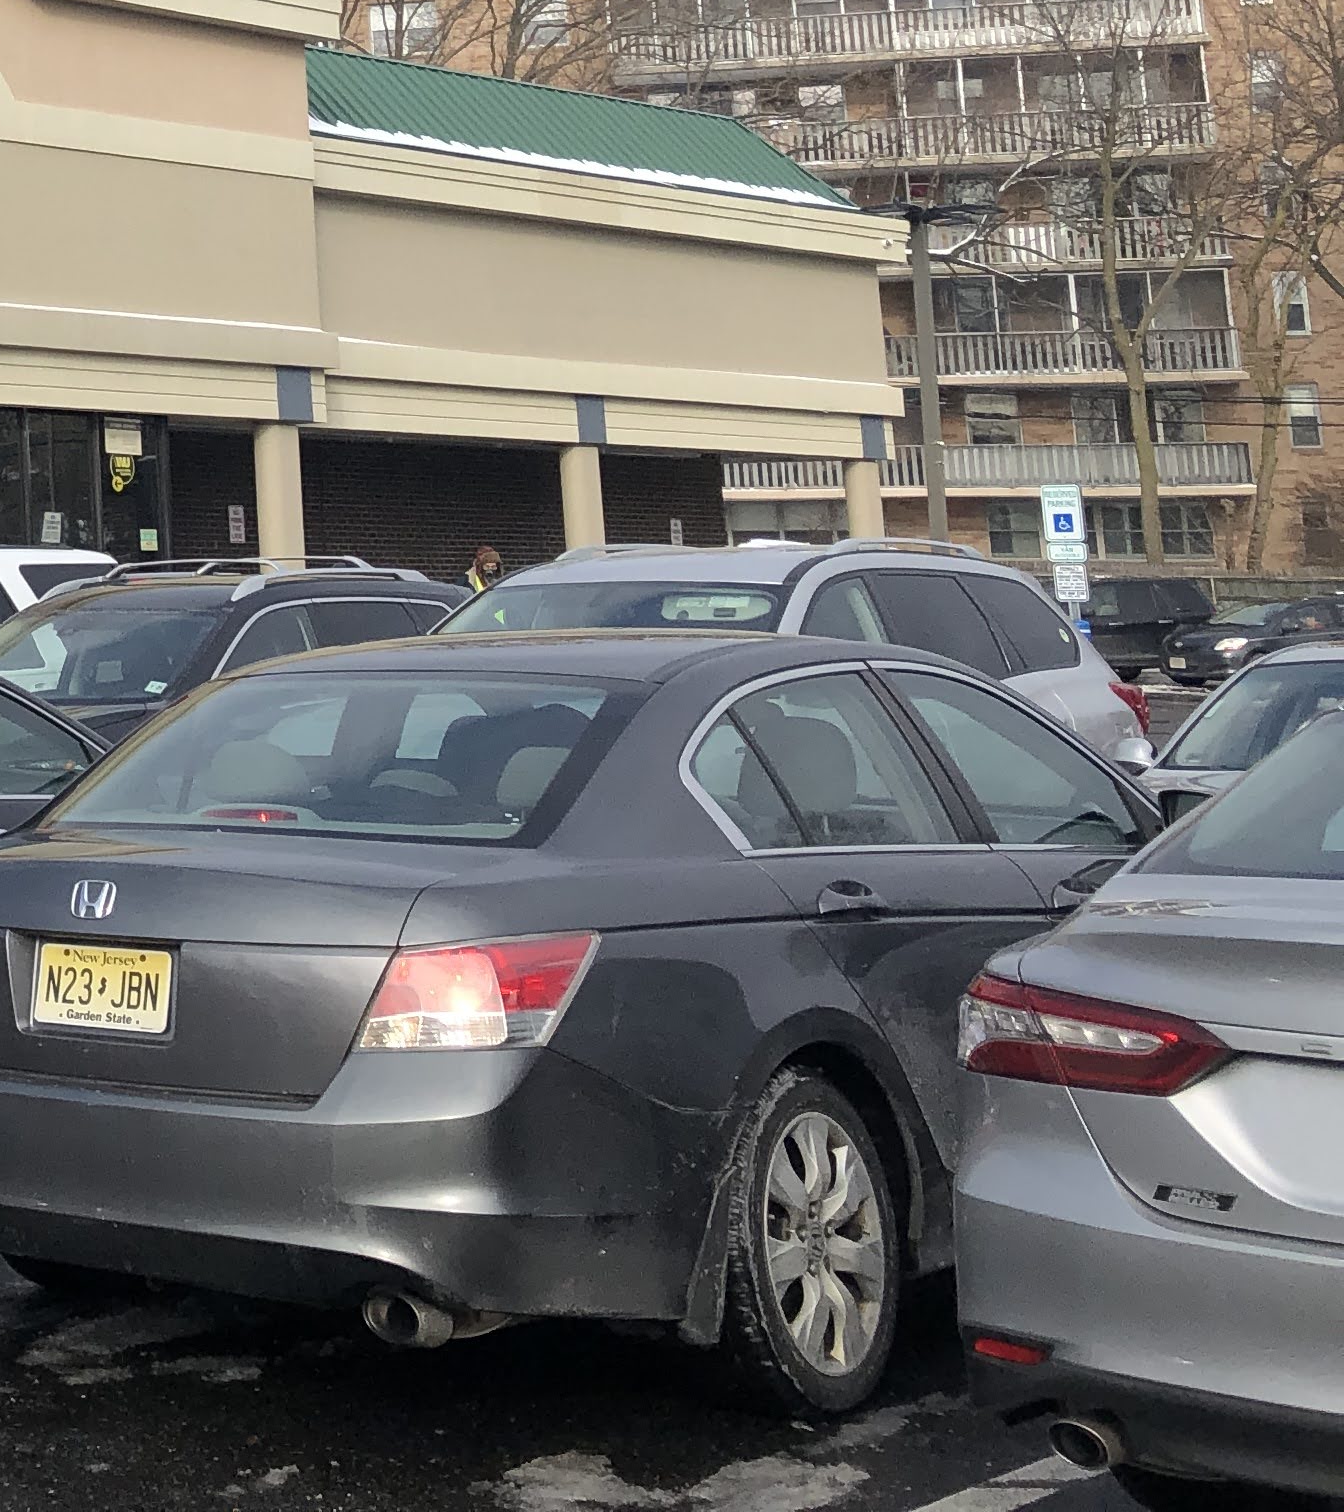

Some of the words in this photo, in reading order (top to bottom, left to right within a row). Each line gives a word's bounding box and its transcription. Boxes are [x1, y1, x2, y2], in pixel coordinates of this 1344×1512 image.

[73, 949, 100, 963] New
[100, 951, 137, 969] Jersey
[45, 965, 93, 1005] N23
[111, 971, 159, 1011] JBN
[66, 1008, 102, 1022] Garden
[105, 1012, 132, 1025] State
